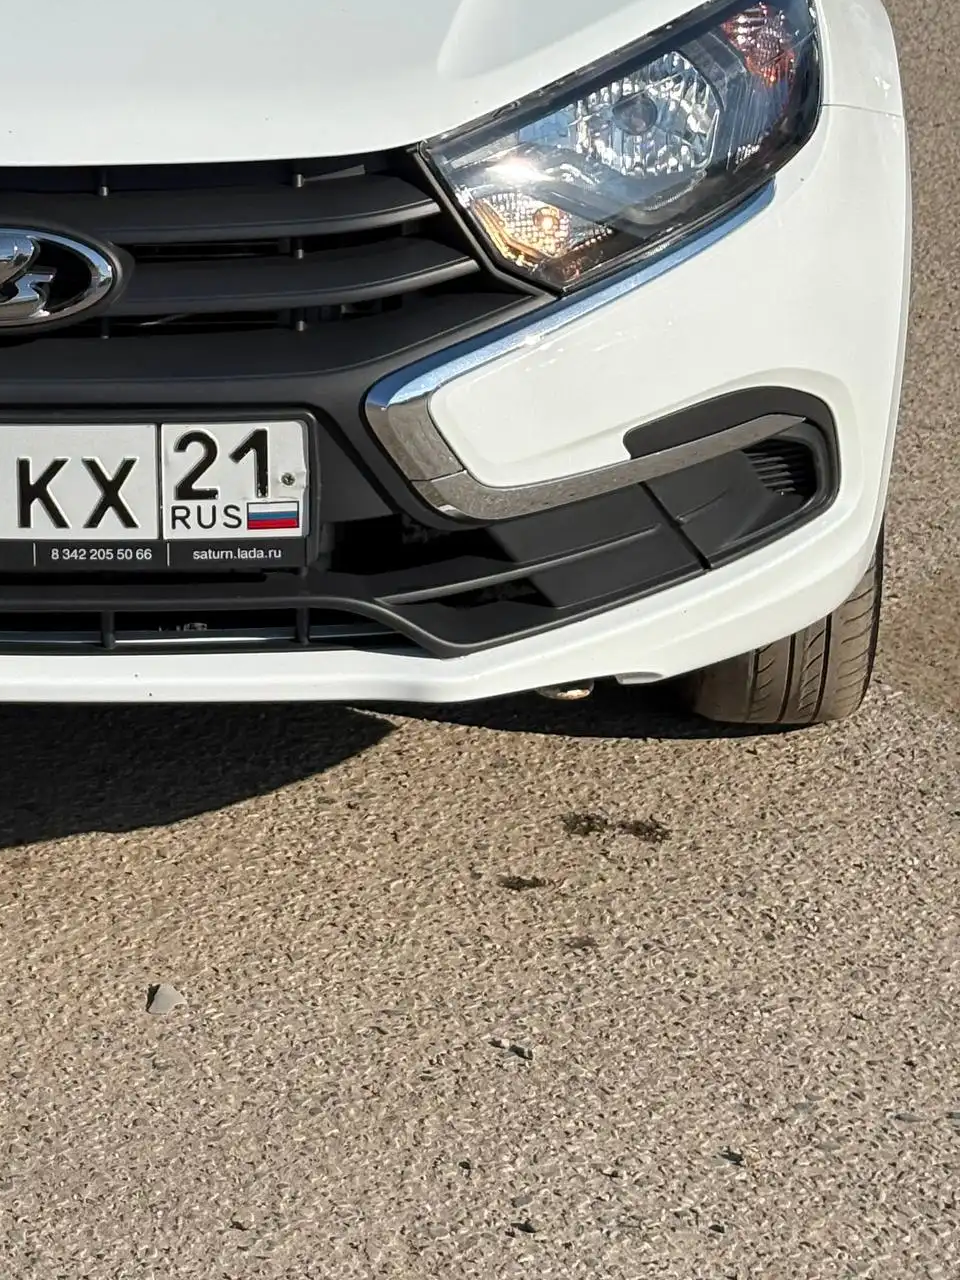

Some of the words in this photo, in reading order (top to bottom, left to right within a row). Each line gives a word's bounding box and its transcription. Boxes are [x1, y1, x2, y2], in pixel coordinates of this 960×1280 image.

[174, 428, 269, 500] 21
[171, 505, 242, 530] RUS
[51, 548, 60, 560] 8
[62, 548, 87, 560] 342
[89, 548, 114, 560] 205
[117, 548, 133, 560] 50
[136, 548, 152, 560] 66
[193, 547, 282, 560] saturn.lada.ru
